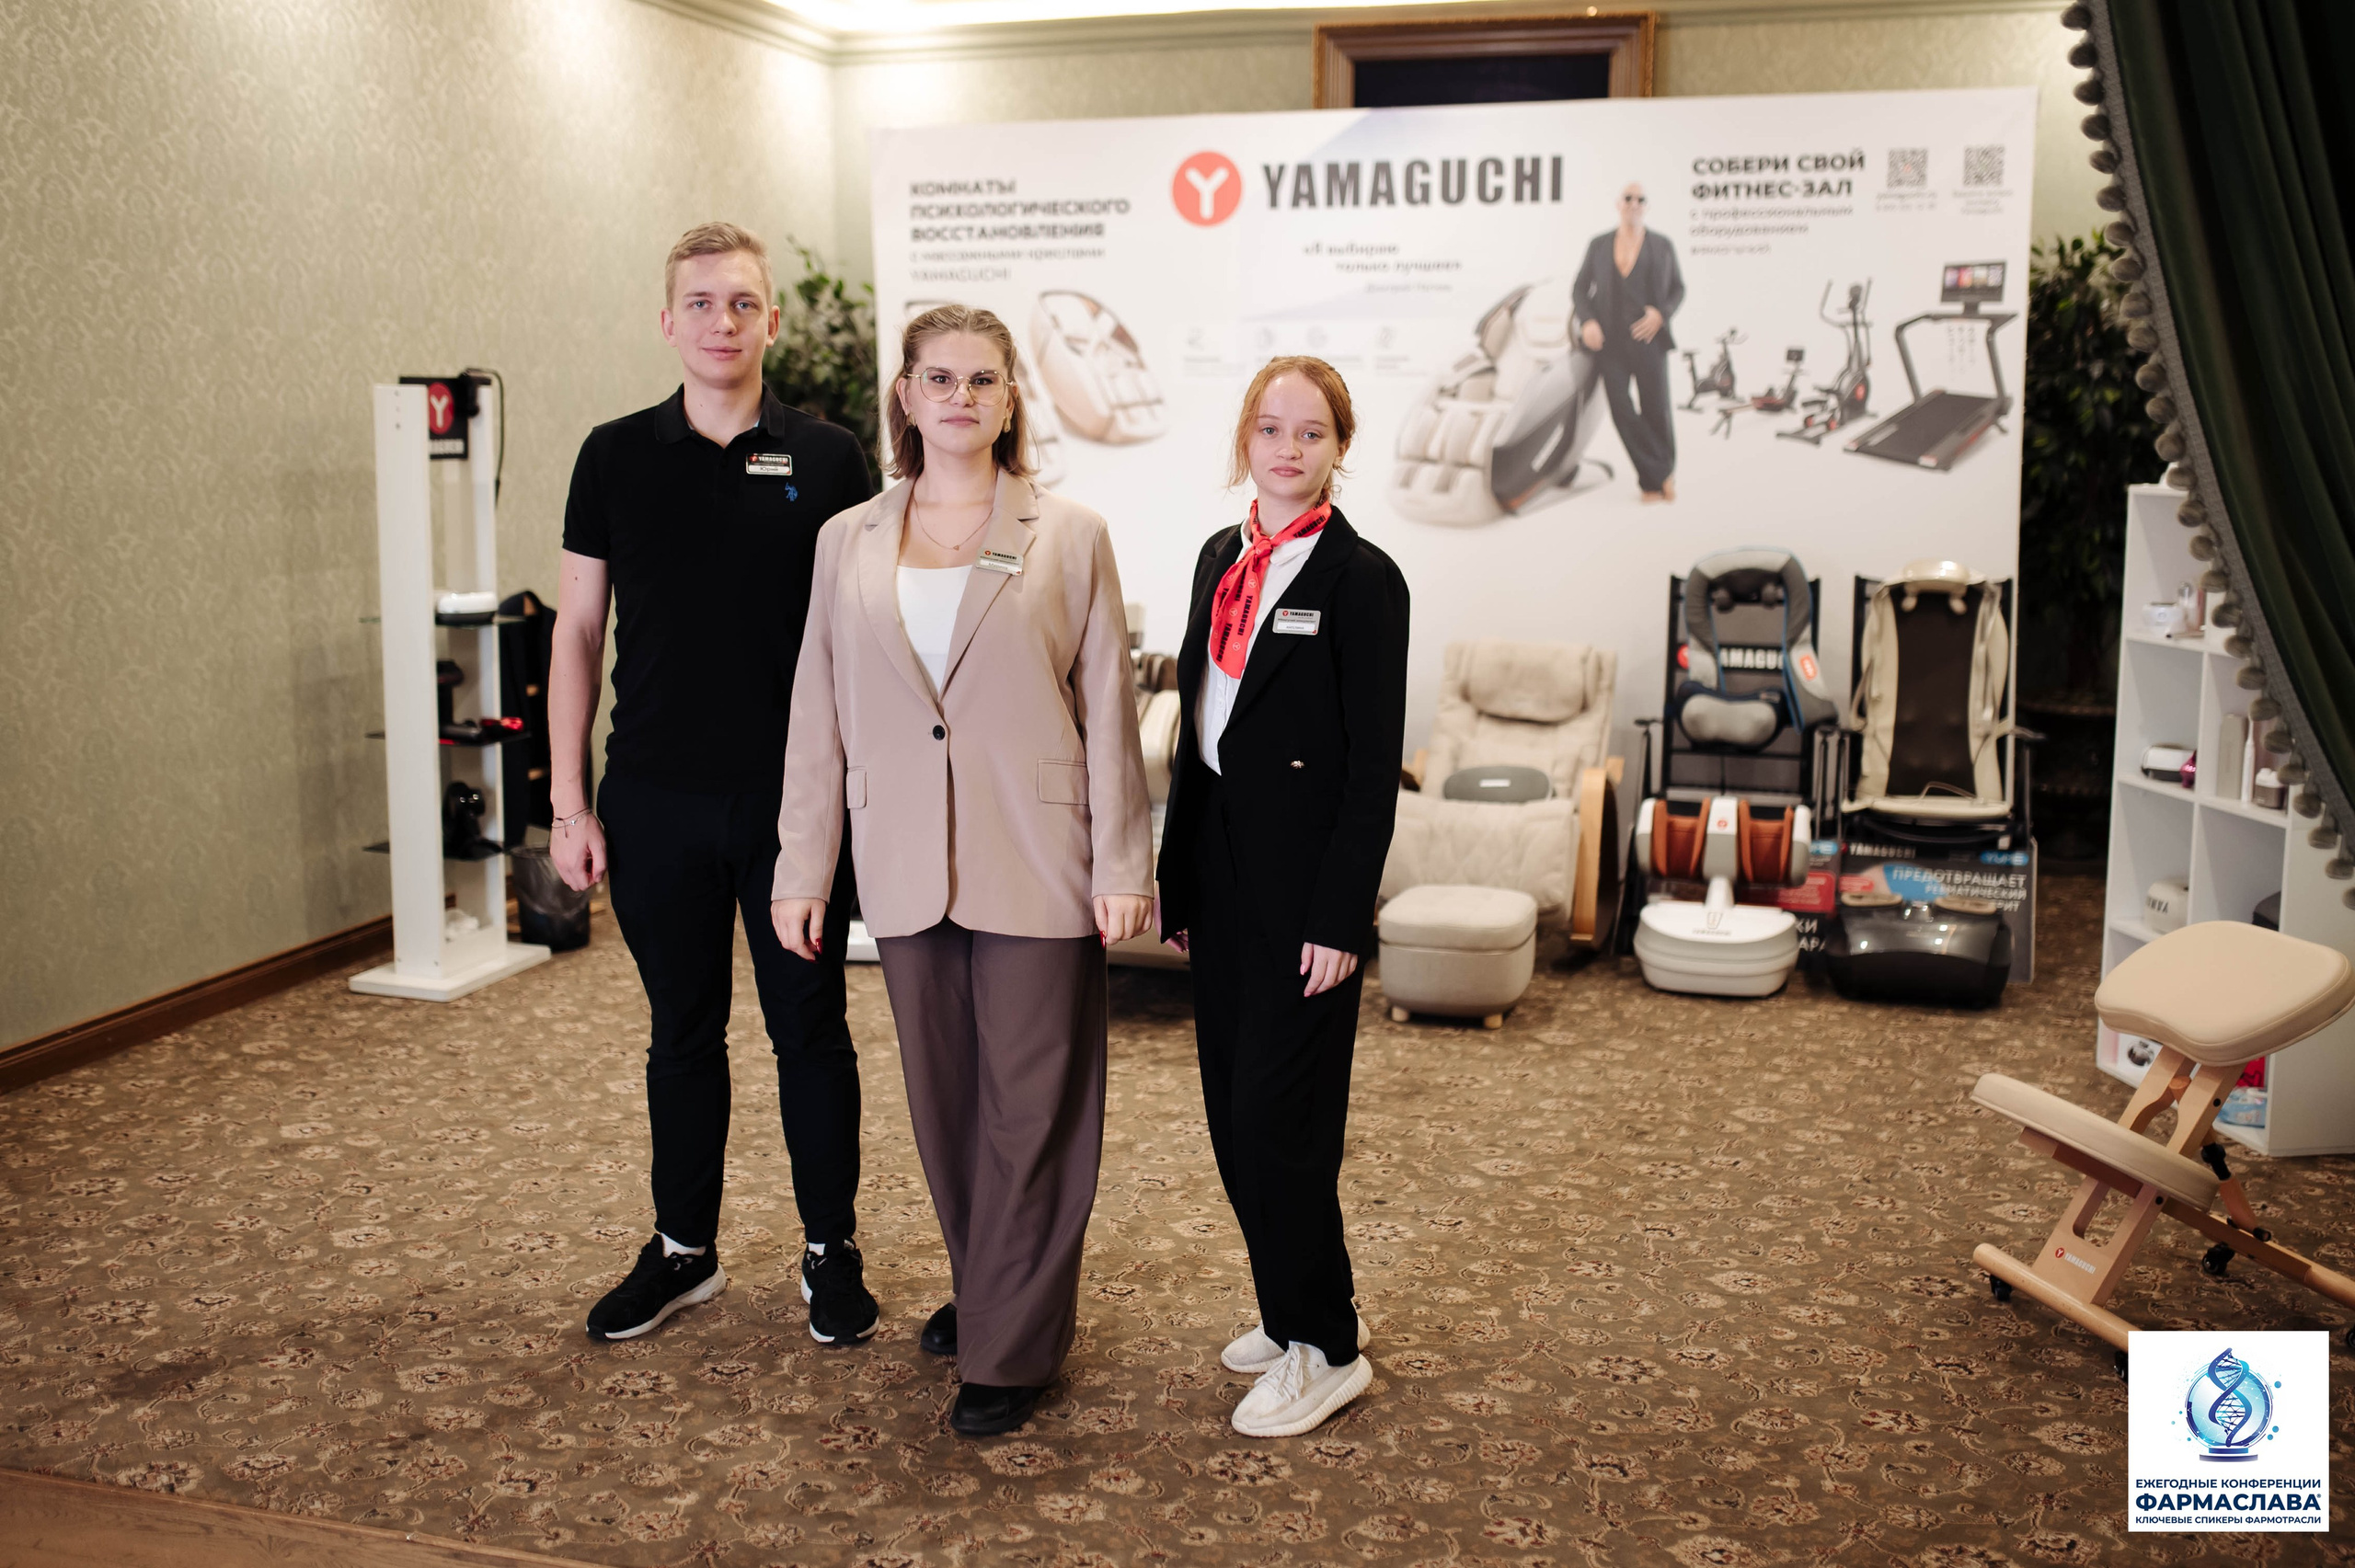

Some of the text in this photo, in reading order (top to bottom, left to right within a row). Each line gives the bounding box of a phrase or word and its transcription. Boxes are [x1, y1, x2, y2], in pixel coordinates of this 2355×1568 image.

[1692, 147, 1866, 176] СОБЕРИ СВОЙ
[910, 179, 1016, 196] КОМНАТЫ
[1262, 155, 1565, 210] YAMAGUCHI
[1691, 178, 1853, 201] ФИТНЕС-ЗАЛ
[910, 199, 1131, 220] ПСИХОЛОГИЧЕСКОГО
[911, 223, 1106, 243] ВОССТАНОВЛЕНИЯ
[1720, 647, 1784, 670] AMAGU
[1891, 865, 2027, 888] ПРЕДОТВРАЩАЕТ
